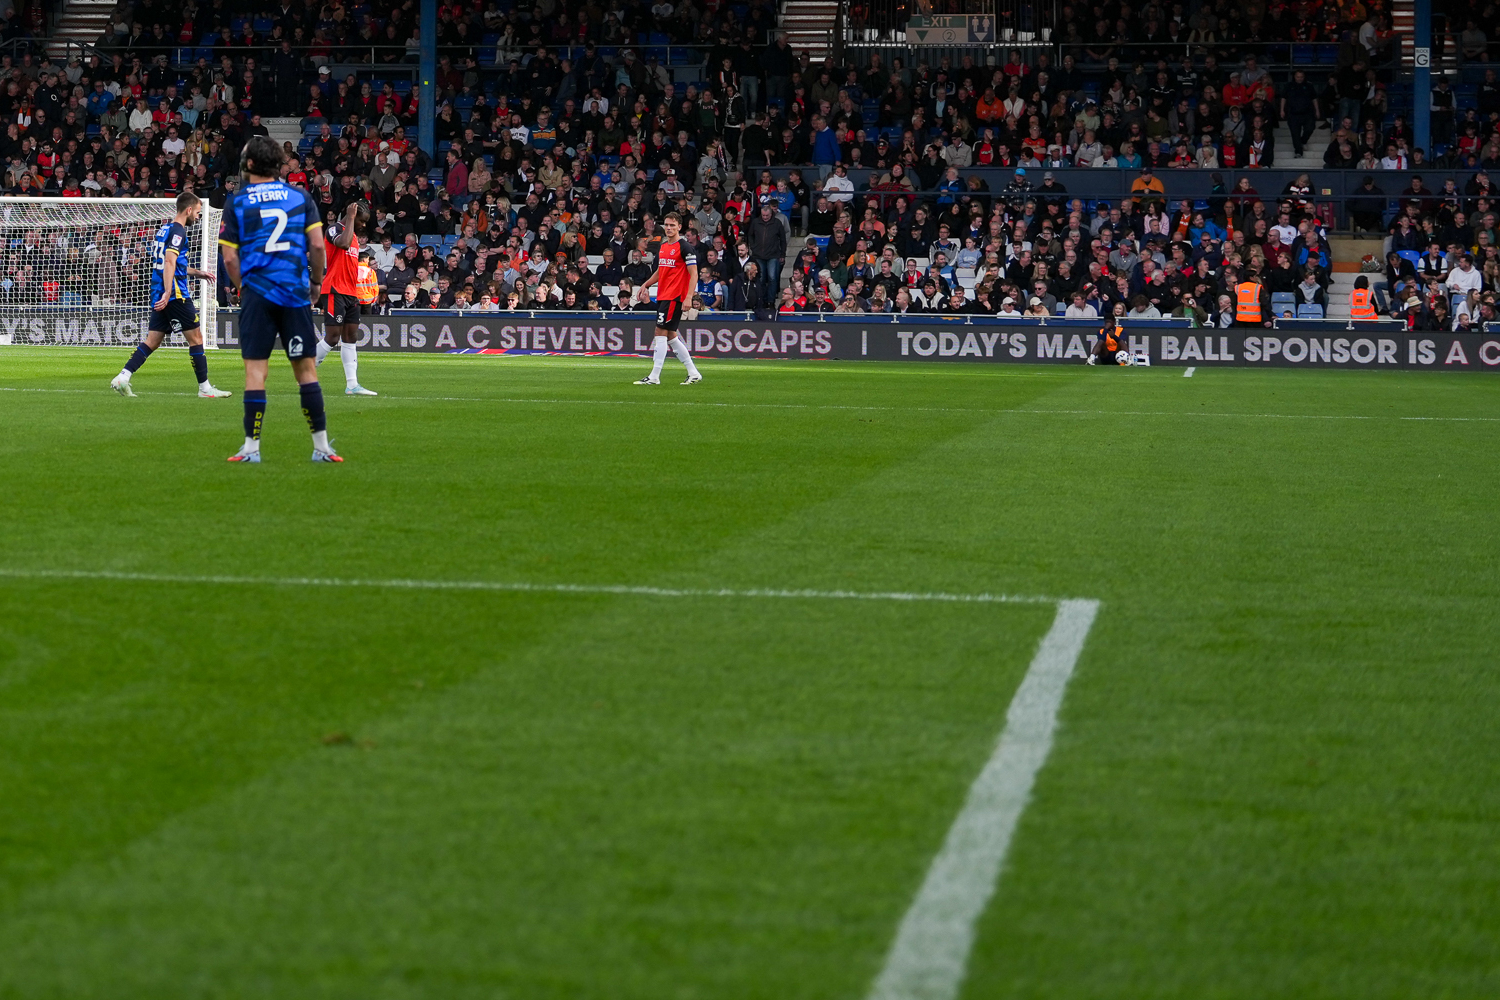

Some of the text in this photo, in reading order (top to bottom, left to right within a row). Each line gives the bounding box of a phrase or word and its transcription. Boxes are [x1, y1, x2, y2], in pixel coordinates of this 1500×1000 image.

[922, 16, 953, 27] EXIT
[946, 31, 952, 41] 2
[1416, 54, 1428, 66] G
[248, 190, 288, 204] STERRY
[260, 208, 290, 253] 2
[657, 312, 665, 323] 3
[400, 323, 427, 348] IS
[435, 324, 457, 348] A
[466, 324, 490, 349] C
[500, 325, 624, 351] STEVENS
[897, 331, 1024, 358] TODAY'S
[1161, 335, 1235, 361] BALL
[1243, 336, 1398, 363] SPONSOR
[1408, 339, 1437, 365] IS
[1445, 340, 1469, 365] A
[1478, 340, 1500, 366] C
